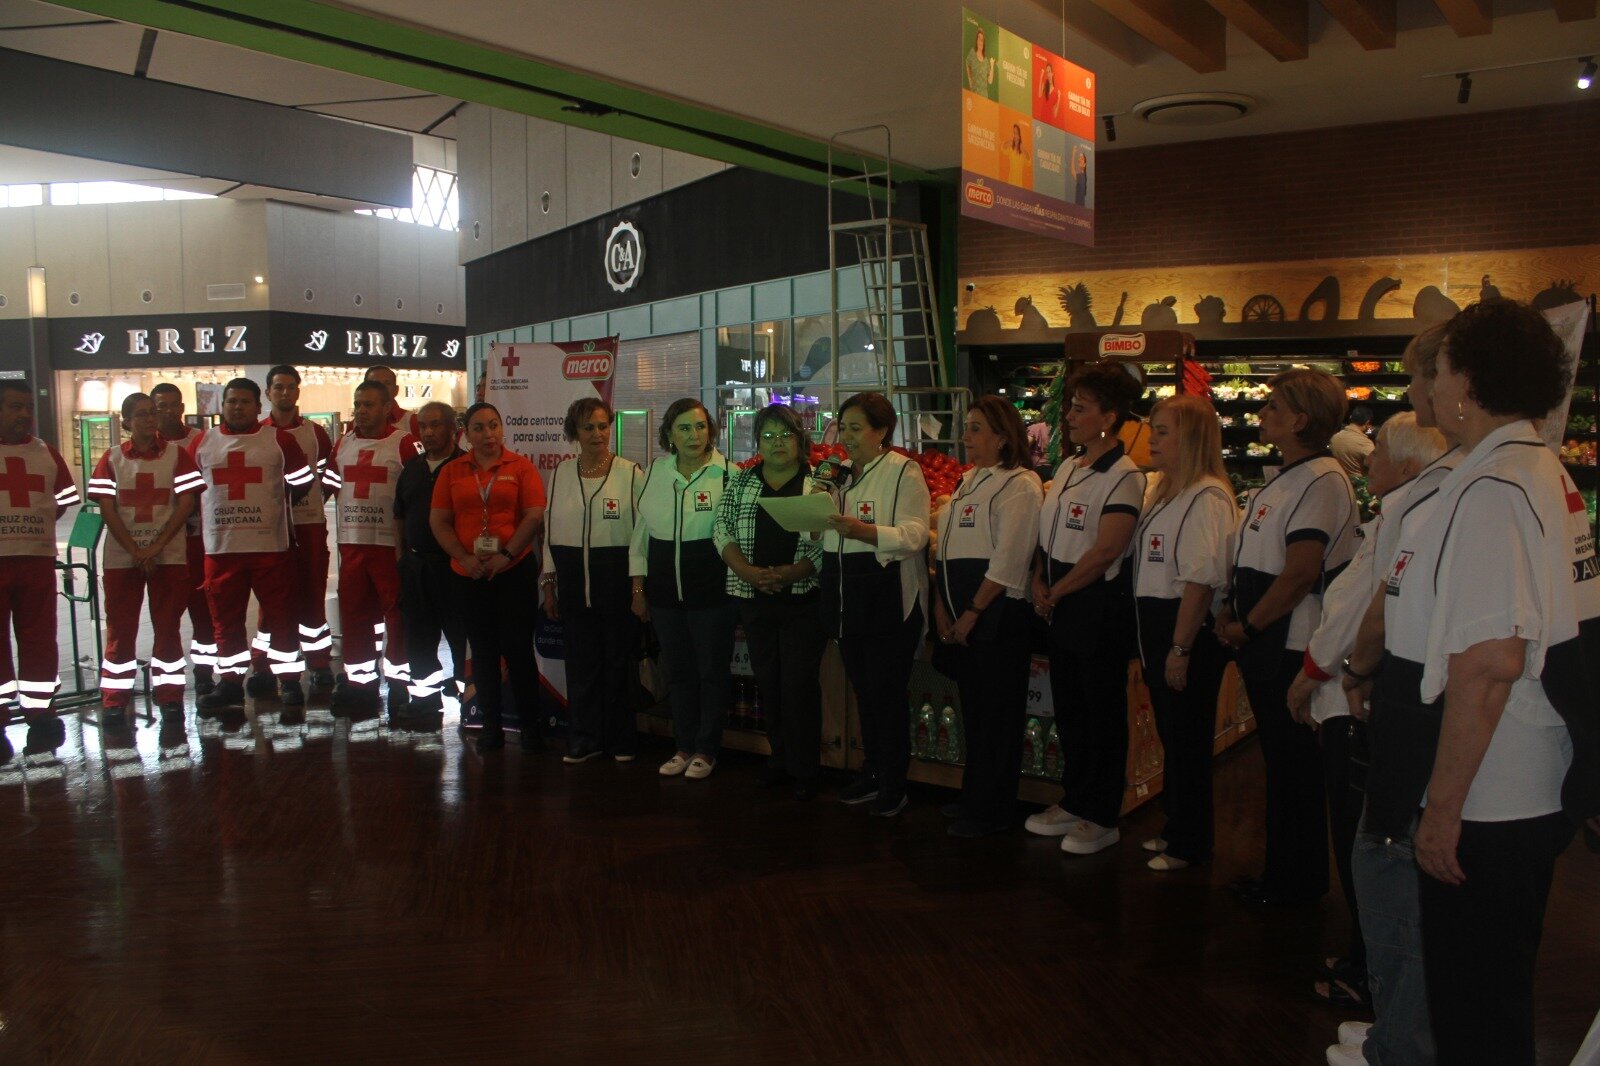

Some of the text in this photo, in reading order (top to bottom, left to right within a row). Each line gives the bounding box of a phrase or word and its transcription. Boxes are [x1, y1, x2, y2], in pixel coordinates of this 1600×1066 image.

[968, 187, 992, 203] merco
[611, 240, 635, 273] C&A
[127, 325, 247, 354] EREZ
[346, 330, 428, 358] EREZ
[1104, 340, 1141, 351] BIMBO
[567, 359, 609, 374] merco
[505, 415, 564, 426] Cada centavo
[513, 433, 533, 444] para
[535, 431, 561, 442] salvar
[214, 506, 262, 516] CRUZ ROJA
[360, 505, 384, 515] ROJA
[215, 516, 262, 525] MEXICANA
